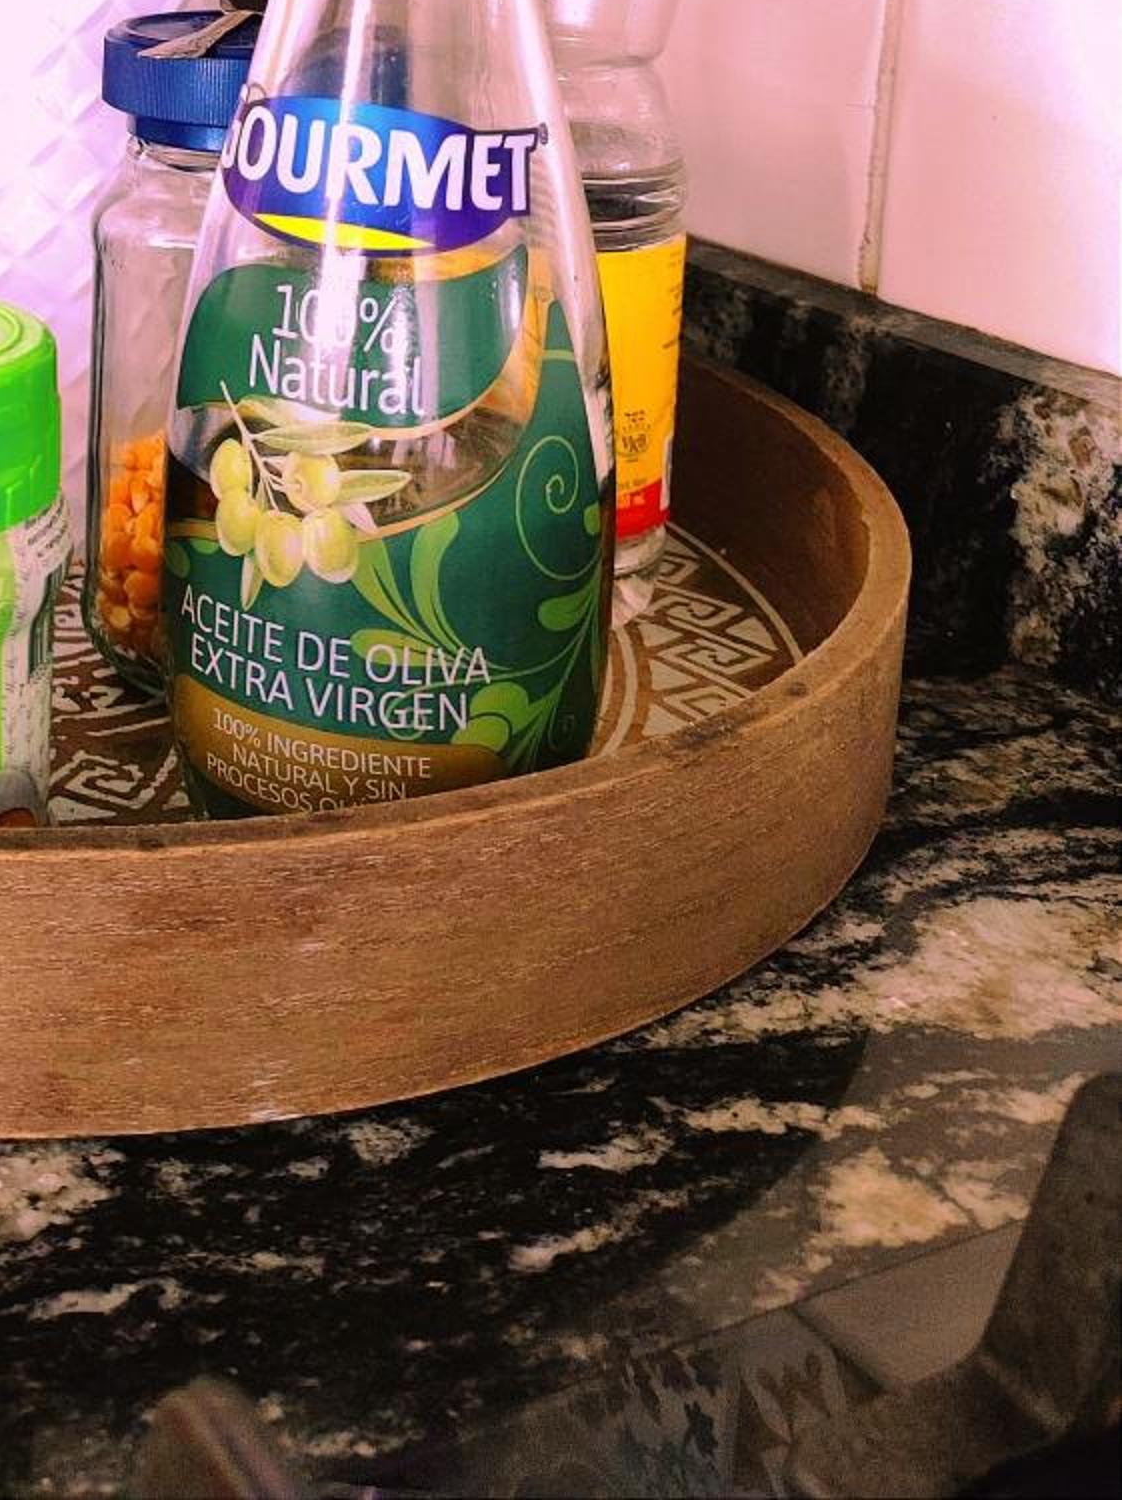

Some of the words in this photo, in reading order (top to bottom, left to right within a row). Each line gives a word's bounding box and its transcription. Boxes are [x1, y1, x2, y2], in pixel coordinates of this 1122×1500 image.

[272, 284, 409, 353] 100%
[249, 334, 425, 416] Natural
[181, 585, 285, 663] ACEITE
[298, 631, 351, 678] DE
[365, 644, 491, 685] OLIVA
[191, 633, 294, 710] EXTRA
[306, 678, 468, 731] VIRGEN
[213, 708, 262, 748] 100%
[267, 732, 431, 779] INGREDIENTE
[233, 744, 337, 795] NATURAL
[343, 775, 360, 796] Y
[366, 779, 406, 800] SIN
[207, 753, 313, 813] PROCESOS
